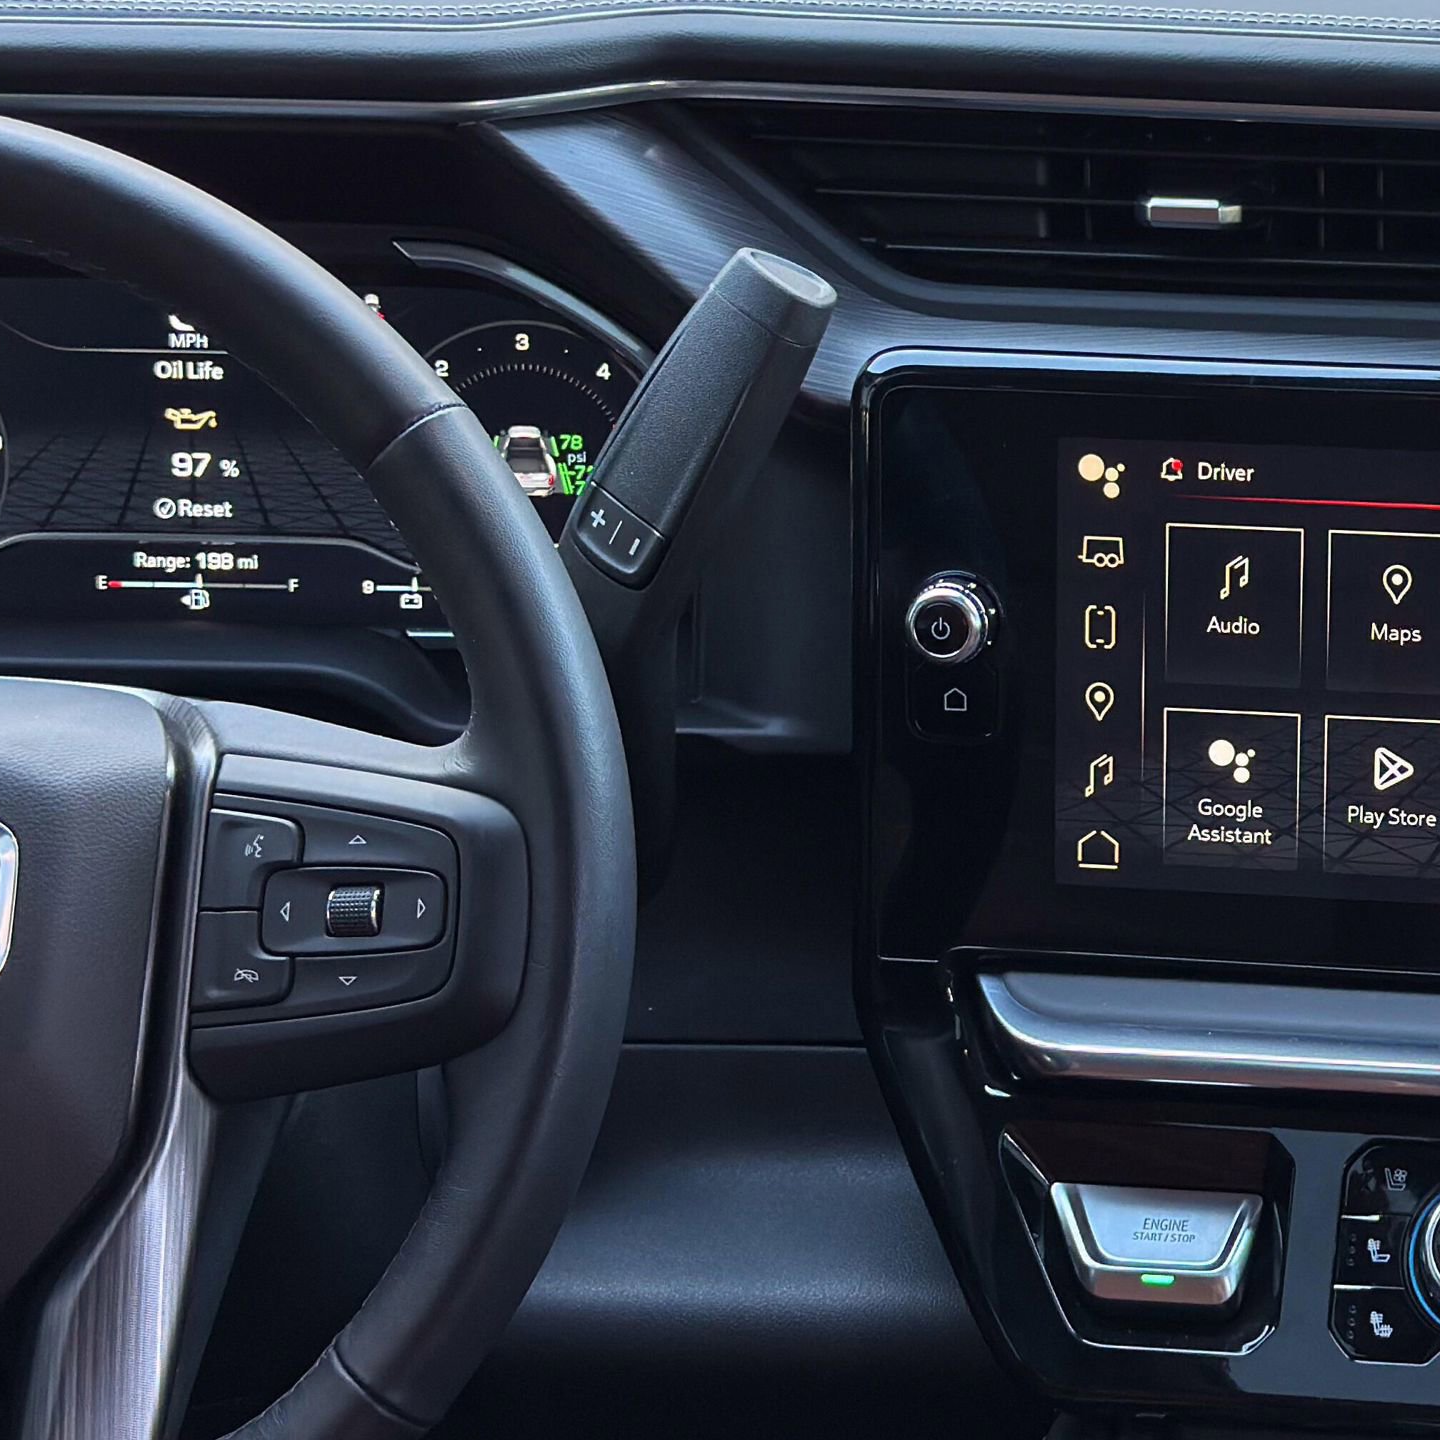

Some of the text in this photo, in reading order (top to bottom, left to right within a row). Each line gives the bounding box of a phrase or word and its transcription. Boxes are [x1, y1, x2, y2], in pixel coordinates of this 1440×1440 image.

[168, 332, 208, 349] MPH
[514, 333, 530, 351] 3
[153, 361, 224, 381] Oil Life
[434, 360, 449, 377] 2
[595, 362, 611, 380] 4
[559, 435, 584, 450] 78
[170, 452, 240, 478] 97 %
[567, 452, 587, 466] psi
[1197, 460, 1255, 483] Driver
[177, 499, 233, 518] Reset
[133, 551, 191, 573] Range:
[237, 554, 259, 570] mi
[95, 575, 108, 590] E
[288, 578, 300, 592] F
[1206, 614, 1260, 636] Audio
[1370, 622, 1422, 646] Maps
[1197, 798, 1264, 823] Google
[1346, 804, 1437, 830] Play Store
[1187, 824, 1273, 846] Assistant
[1142, 1217, 1190, 1232] ENGINE
